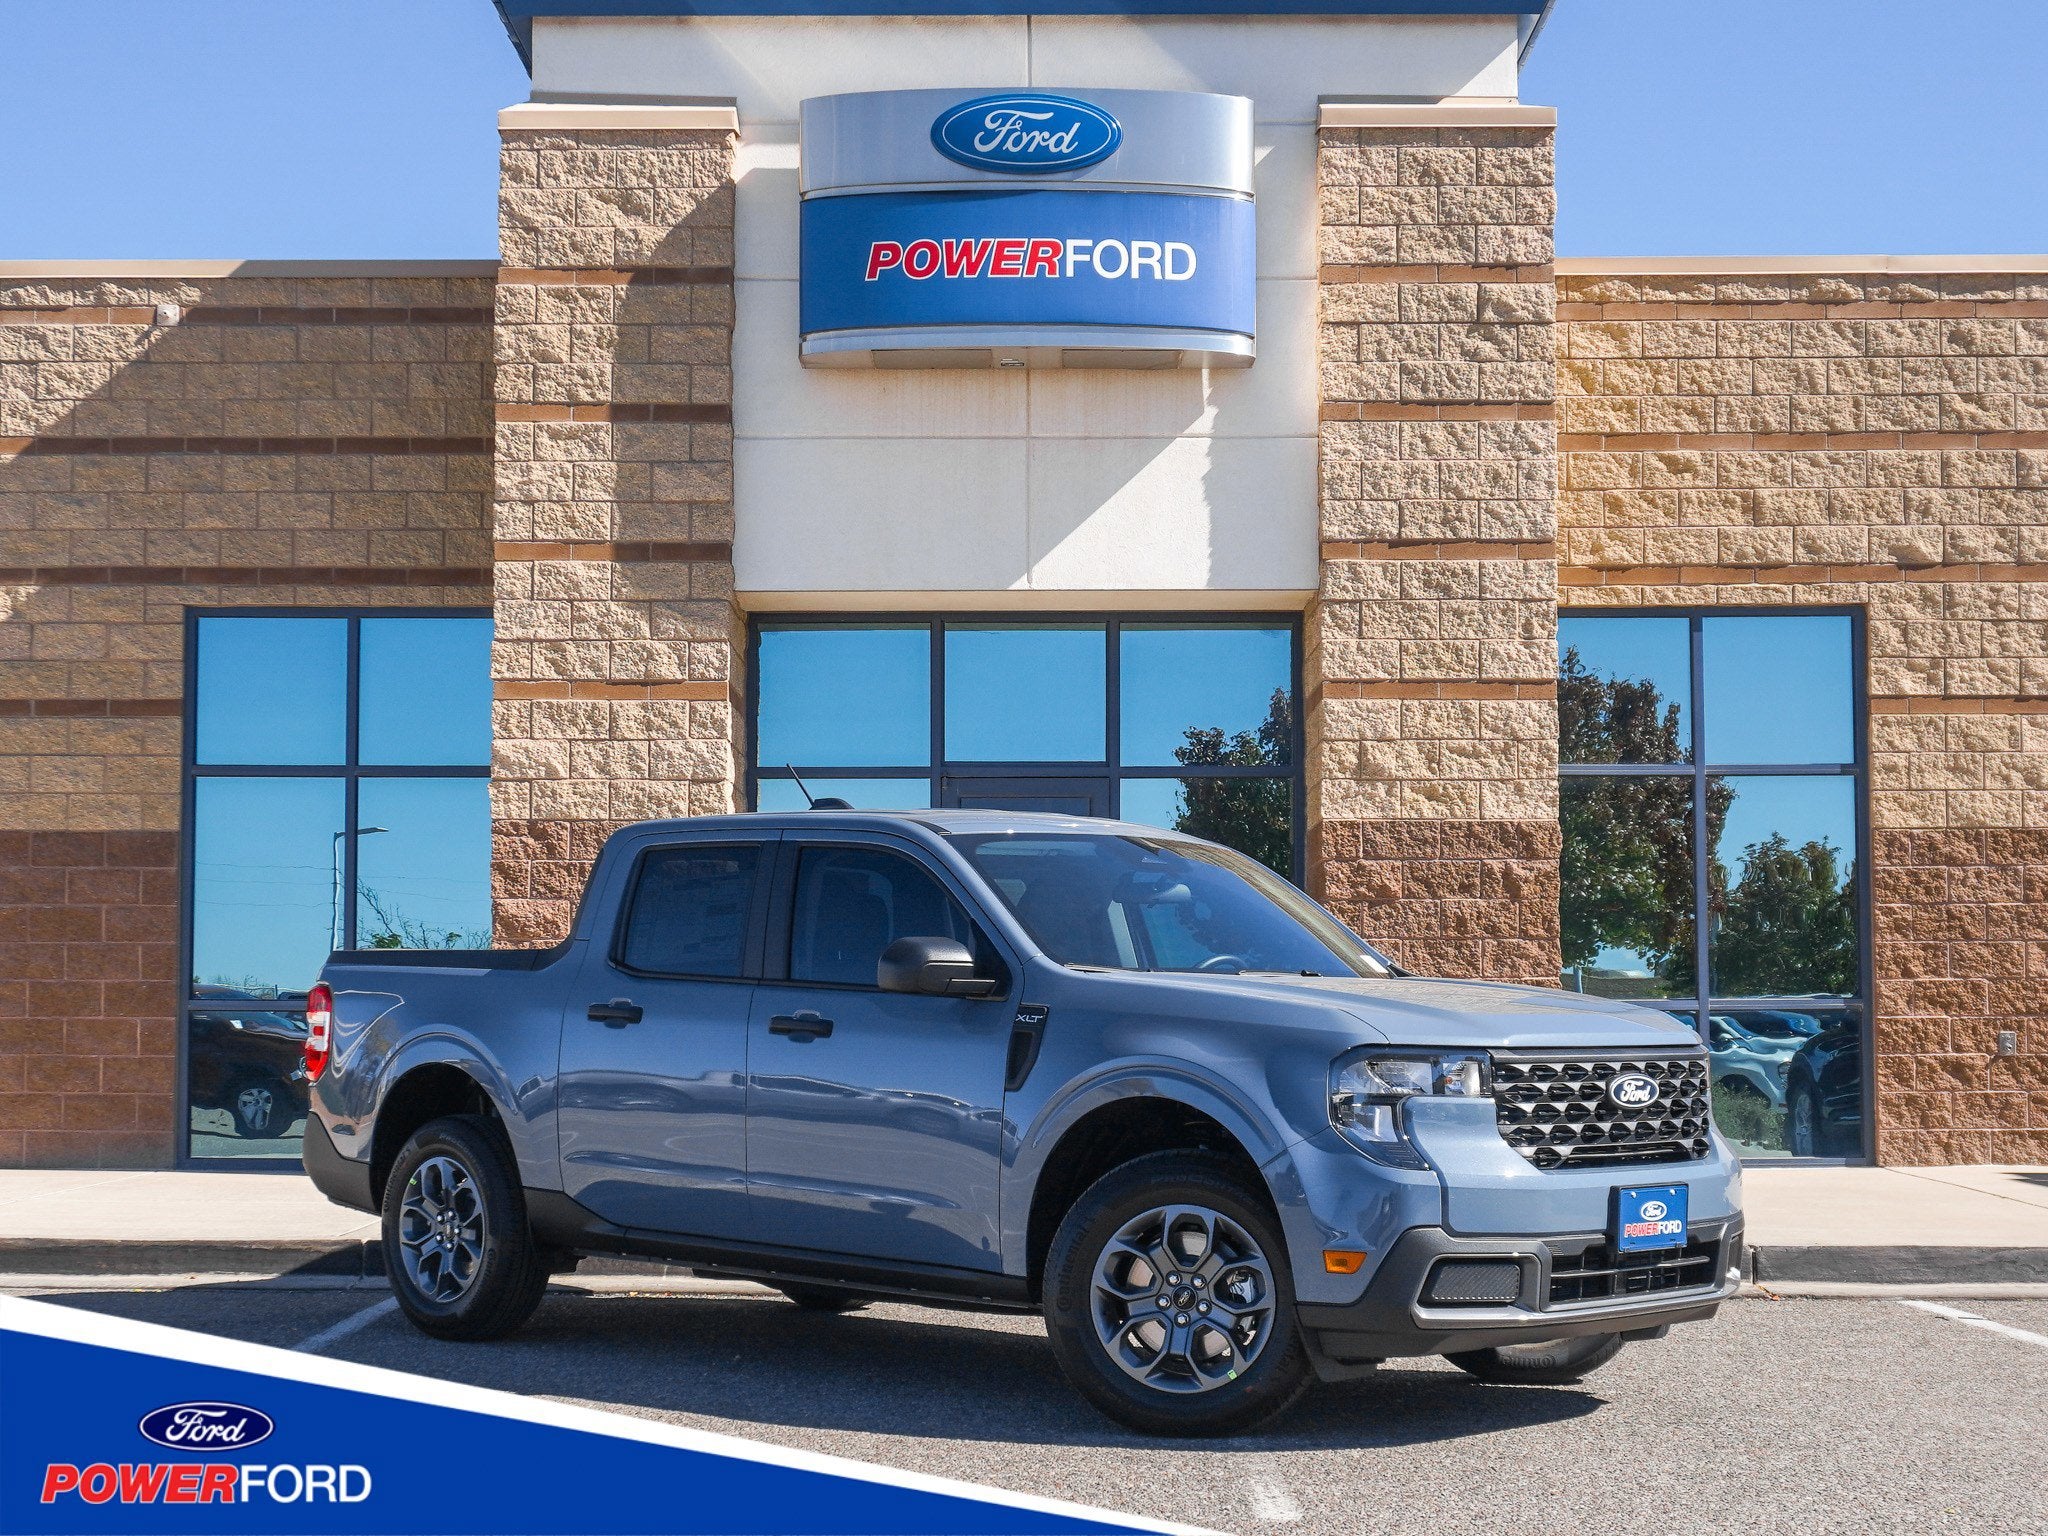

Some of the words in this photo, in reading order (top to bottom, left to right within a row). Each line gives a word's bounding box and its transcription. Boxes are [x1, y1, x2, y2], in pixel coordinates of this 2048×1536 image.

[973, 108, 1081, 155] Ford
[1015, 1014, 1044, 1023] XLT
[1620, 1080, 1652, 1102] Ford
